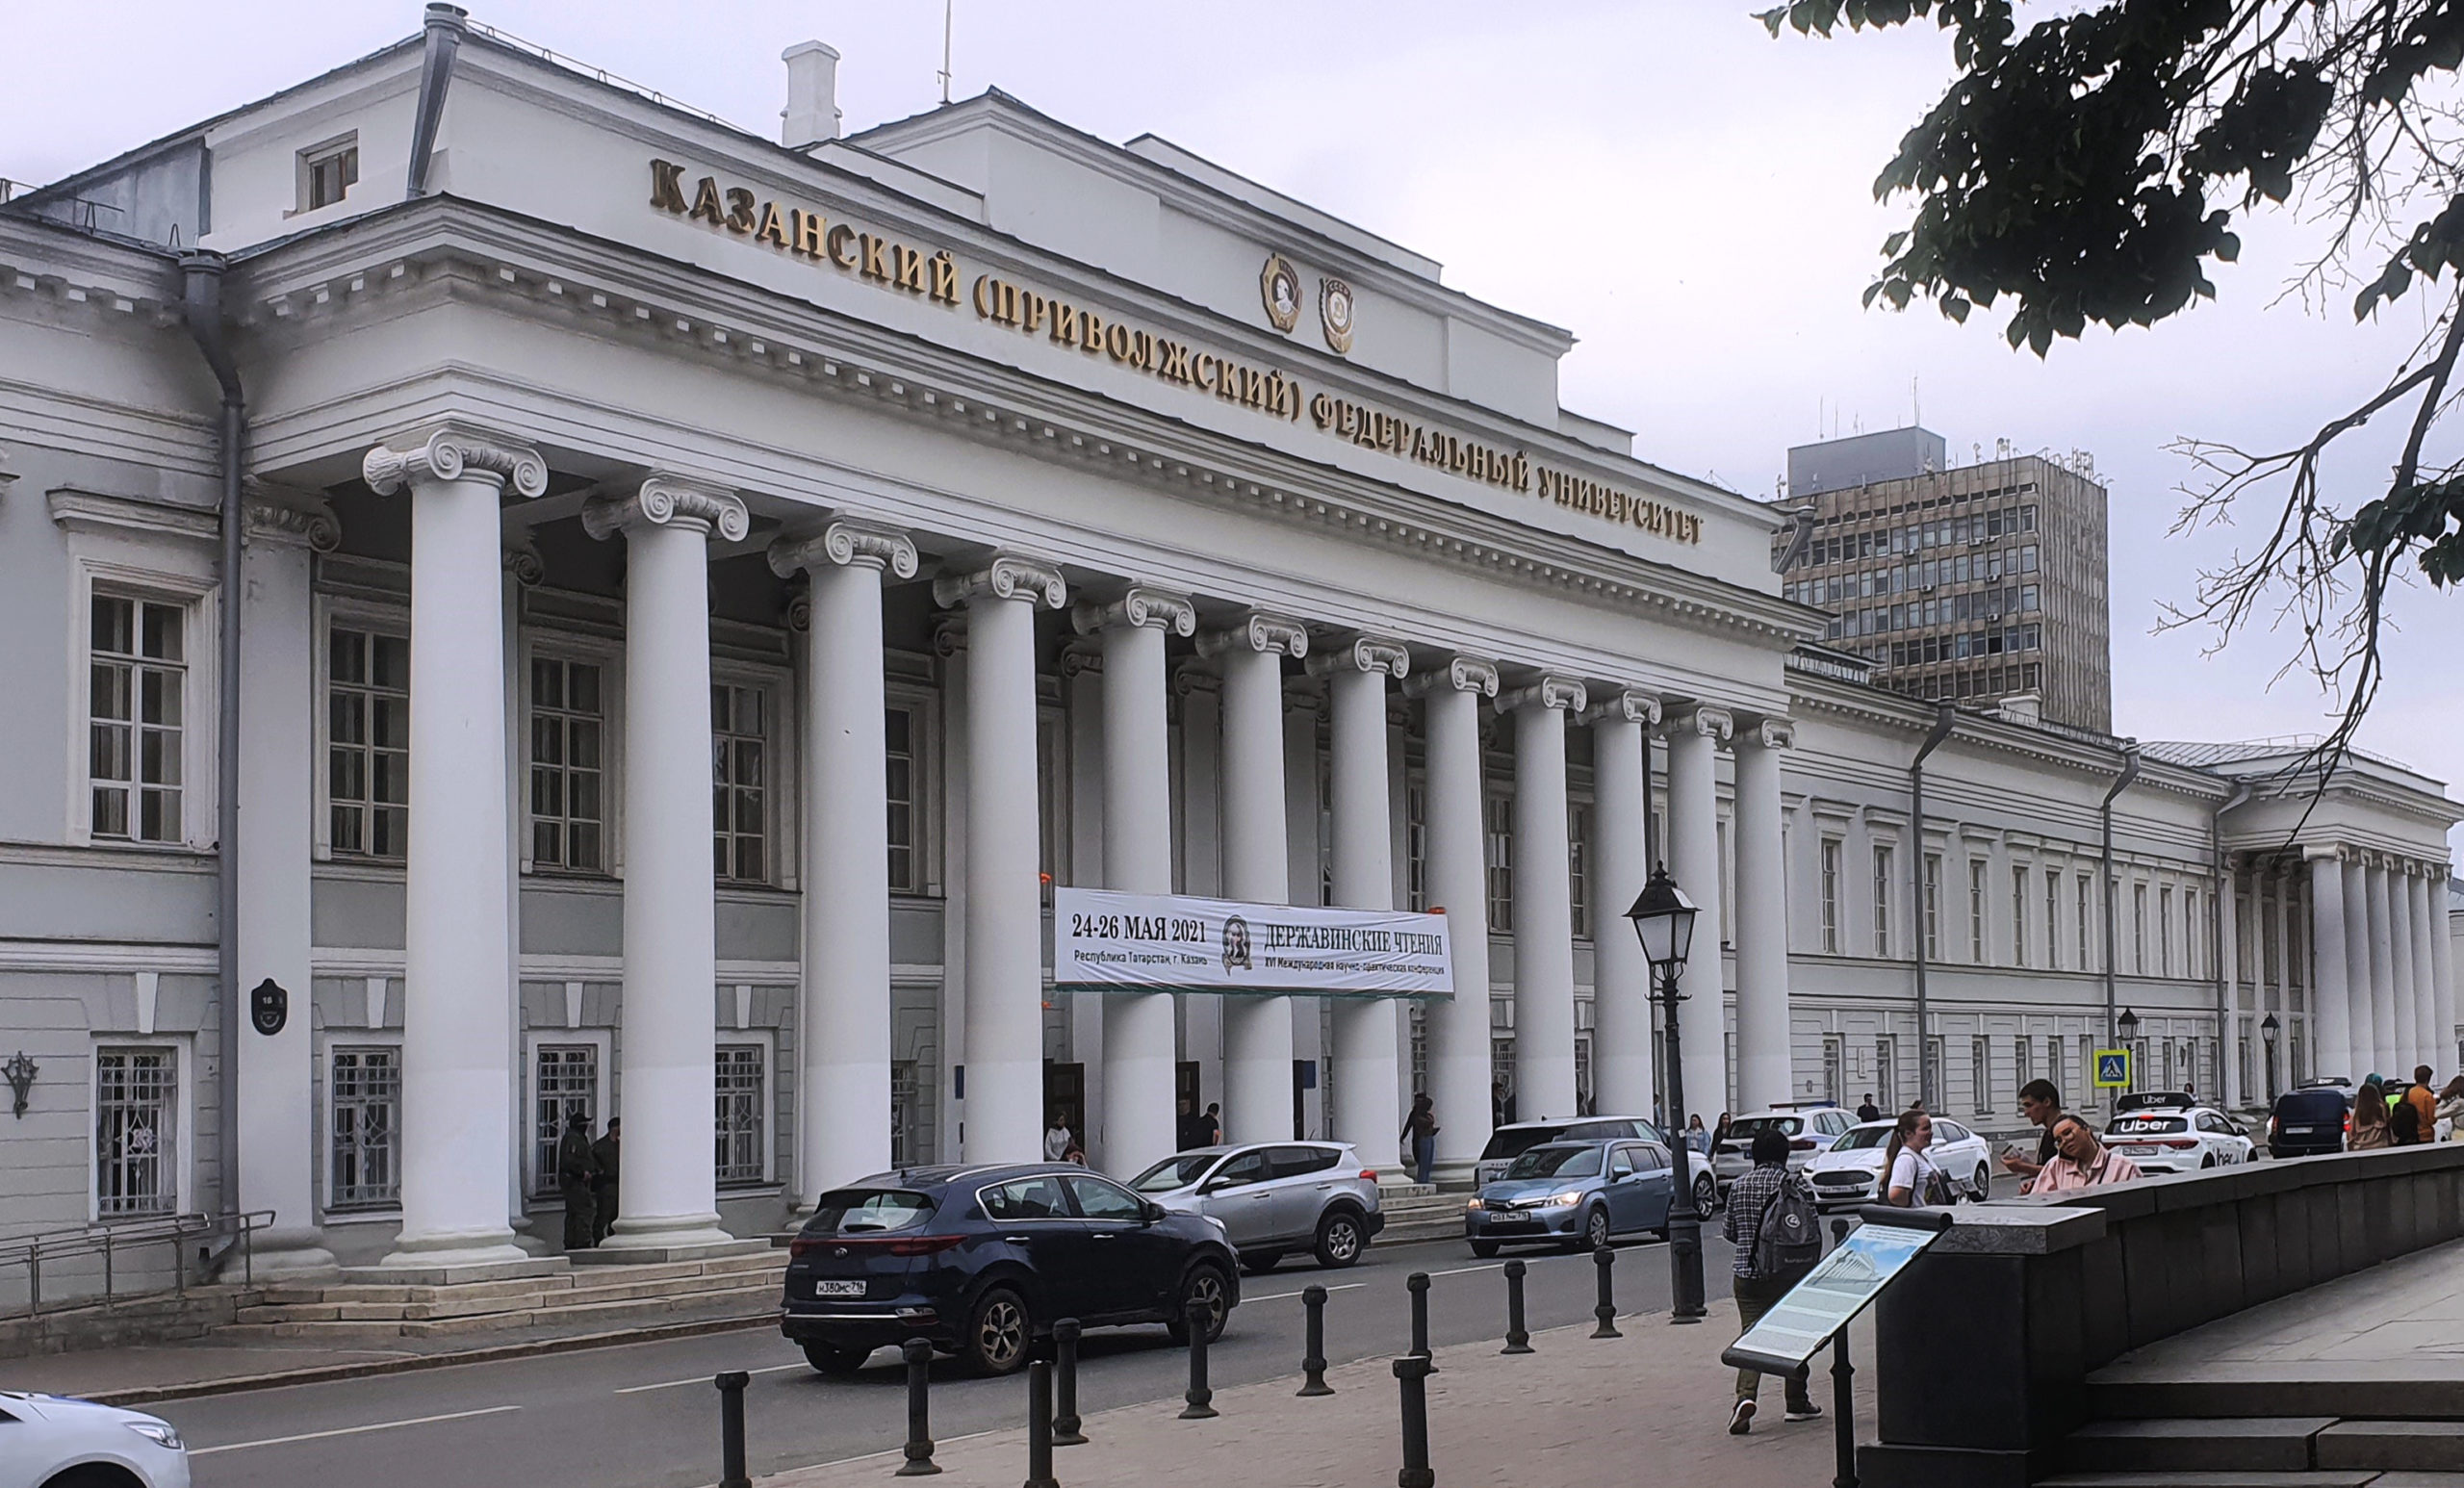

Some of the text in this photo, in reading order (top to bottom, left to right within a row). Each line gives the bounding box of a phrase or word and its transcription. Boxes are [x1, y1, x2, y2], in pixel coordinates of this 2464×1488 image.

[650, 157, 1704, 545] КАЗАНСКИЙ (ПРИВОЛЖСКИЙ) ФЕДЕРАЛЬНЫЙ УНИВЕРСИТЕТ
[1072, 913, 1206, 942] 24-26 МАЯ 2021
[1264, 924, 1443, 956] ДЕРЖАВИНСКИЕ ЧТЕНИЯ
[1074, 949, 1126, 965] Республика
